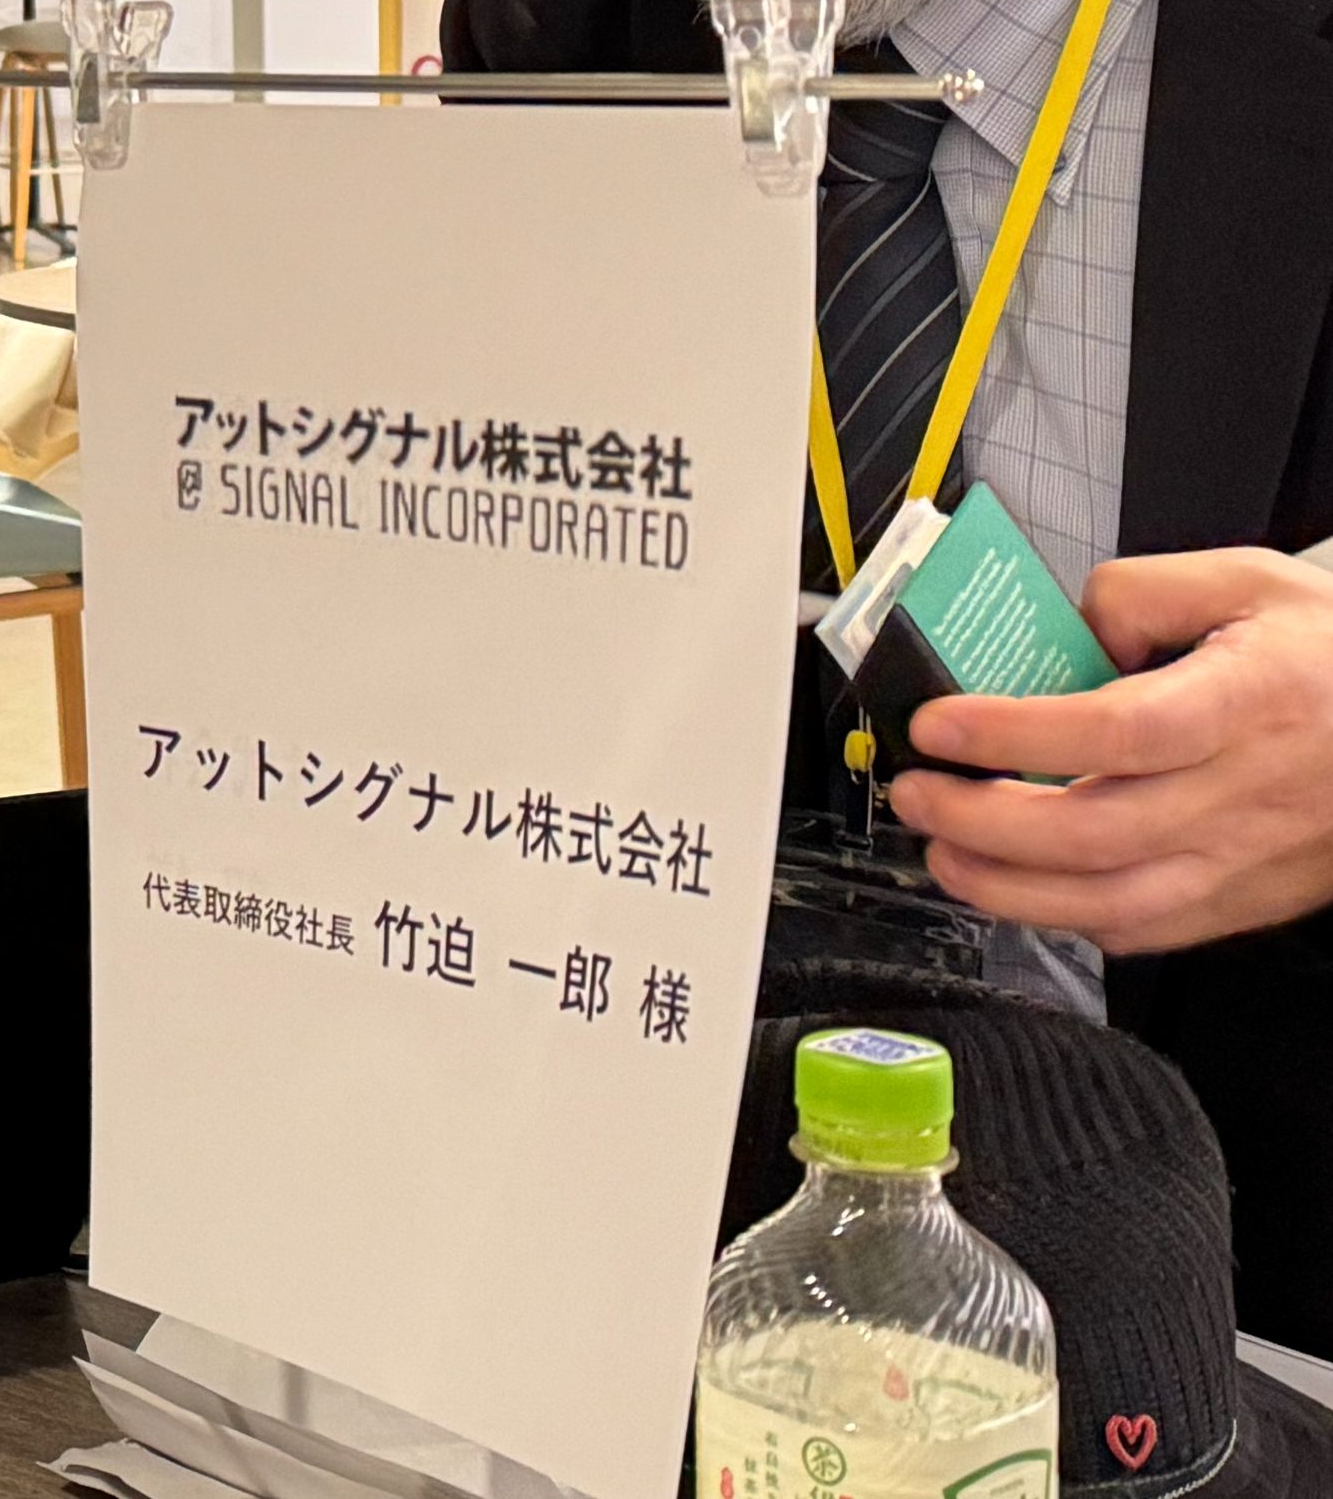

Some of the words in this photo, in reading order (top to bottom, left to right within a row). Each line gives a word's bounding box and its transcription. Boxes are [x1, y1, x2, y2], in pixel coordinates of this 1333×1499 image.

[175, 396, 691, 500] アットシグナル株式会社
[221, 464, 358, 529] SIGNAL
[381, 480, 687, 569] INCORPORATED
[139, 725, 712, 896] アットシグナル株式会社
[143, 873, 353, 955] 代表取締役社長
[375, 901, 475, 987] 竹迫
[509, 946, 611, 1021] 一郎
[640, 965, 690, 1042] 様
